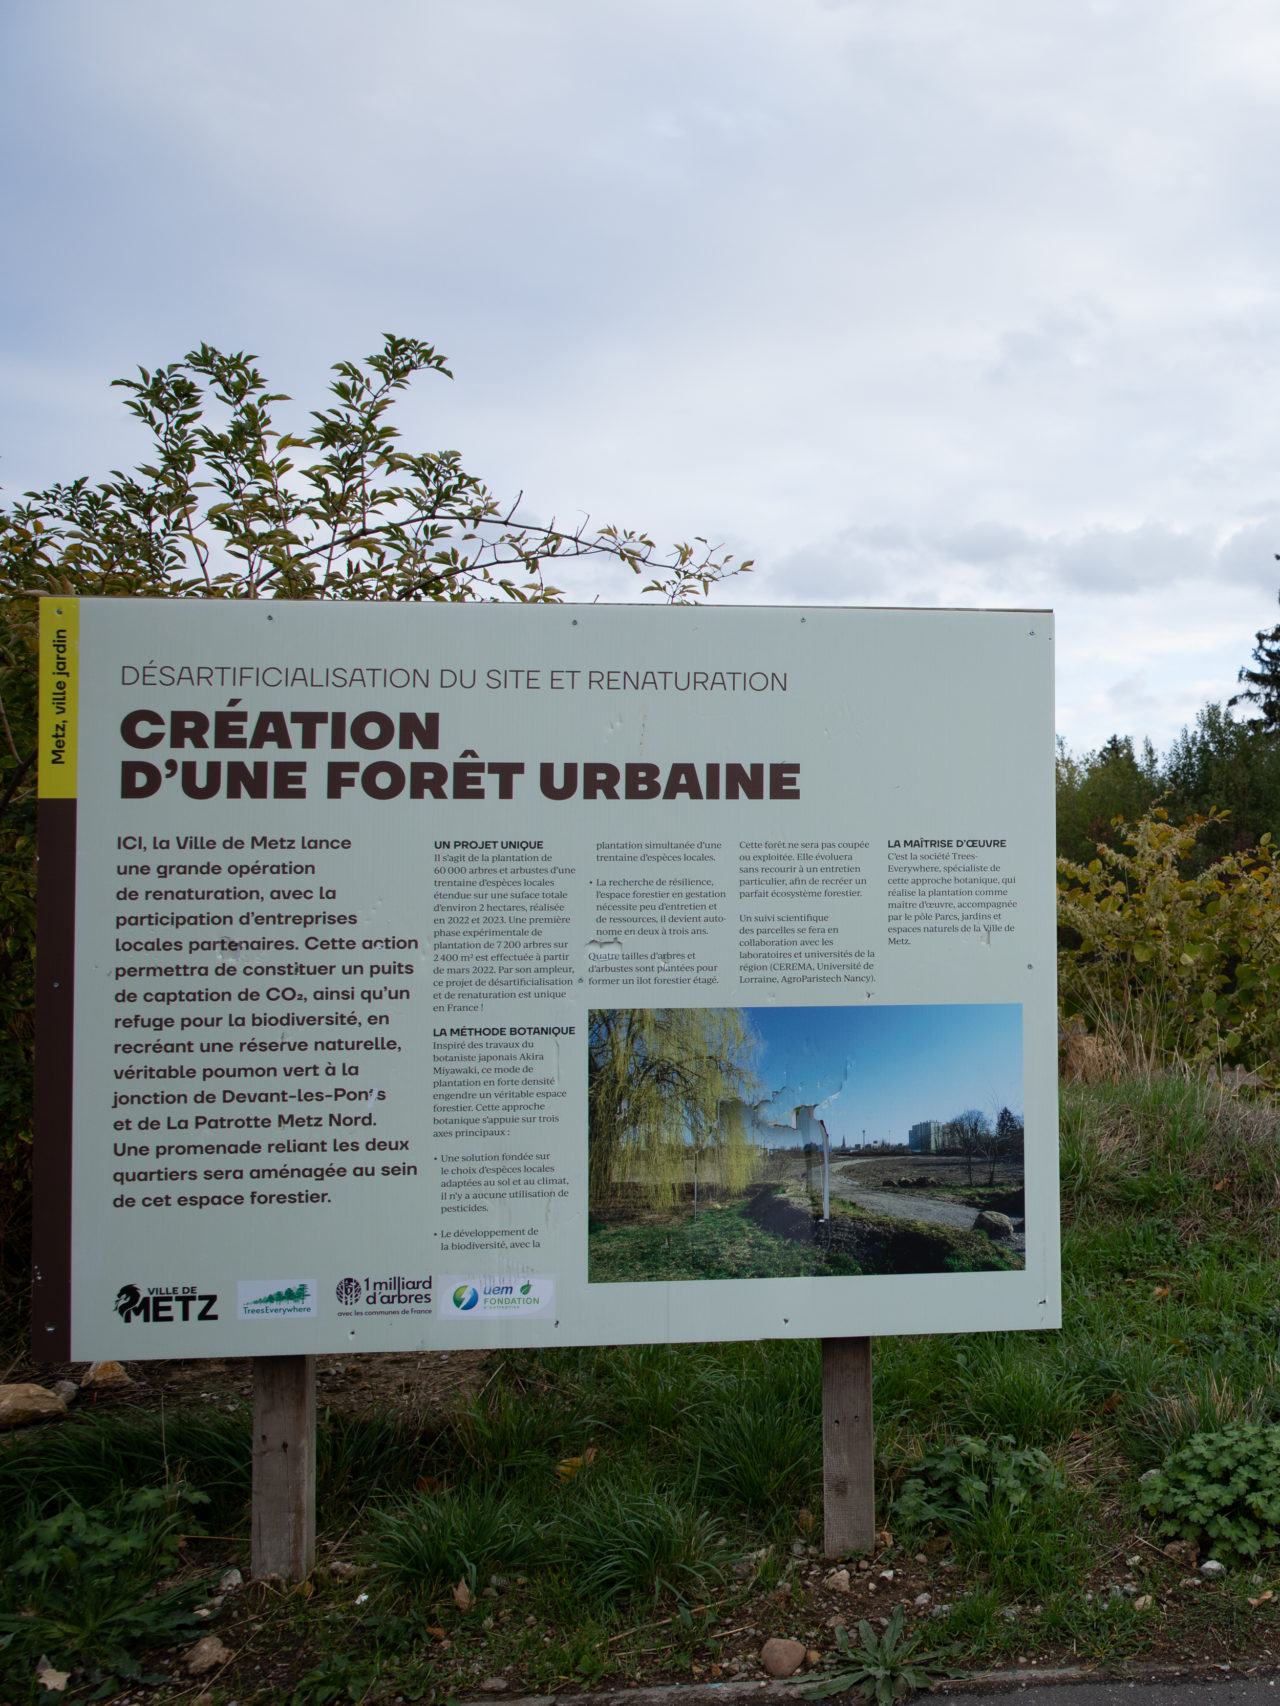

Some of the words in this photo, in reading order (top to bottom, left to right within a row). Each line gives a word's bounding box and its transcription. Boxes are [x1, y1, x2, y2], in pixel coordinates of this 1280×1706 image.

[52, 629, 69, 677] jardin
[121, 660, 430, 688] DÉSARTIFICIALISATION
[440, 668, 477, 688] DU
[486, 669, 541, 689] SITE
[550, 670, 581, 689] ET
[588, 670, 788, 691] RENATURATION
[52, 680, 66, 714] ville
[120, 698, 440, 750] CRÉATION
[51, 720, 67, 764] Metz,
[120, 758, 307, 800] D'UNE
[327, 749, 525, 800] FORÊT
[539, 761, 801, 800] URBAINE
[116, 835, 146, 851] ICI,
[152, 836, 170, 849] la
[175, 835, 216, 849] Ville
[222, 836, 245, 849] de
[250, 835, 296, 849] Metz
[300, 835, 352, 849] lance
[434, 840, 450, 849] UN
[453, 840, 498, 849] PROJET
[501, 840, 543, 851] UNIQUE
[888, 839, 901, 848] LA
[903, 837, 953, 848] MAÎTRISE
[956, 839, 1006, 847] D'ŒUVRE
[434, 853, 440, 861] Il
[442, 854, 466, 863] s'agit
[468, 853, 479, 861] de
[481, 853, 490, 861] la
[491, 853, 539, 863] plantation
[541, 853, 552, 861] de
[596, 853, 638, 861] trentaine
[640, 853, 682, 863] d'espèces
[683, 853, 715, 861] locales.
[752, 853, 794, 862] exploitée.
[797, 852, 814, 860] Elle
[815, 852, 852, 860] évoluera
[887, 852, 908, 860] C'est
[910, 852, 918, 860] la
[920, 852, 950, 860] société
[951, 852, 978, 860] Trees-
[116, 864, 151, 875] une
[156, 861, 222, 878] grande
[226, 859, 315, 878] opération
[434, 878, 478, 886] trentaine
[478, 878, 522, 888] d'espèces
[523, 878, 554, 886] locales
[115, 887, 139, 900] de
[144, 886, 264, 902] renaturation,
[269, 889, 314, 899] avec
[318, 886, 336, 899] la
[596, 902, 637, 911] nécessite
[639, 904, 656, 912] peu
[658, 902, 706, 910] d'entretien
[115, 911, 233, 929] participation
[238, 910, 357, 928] d'entreprises
[447, 916, 469, 924] 2022
[471, 916, 480, 924] et
[482, 916, 506, 924] 2023.
[508, 915, 527, 923] Une
[529, 915, 570, 925] première
[739, 914, 752, 922] Un
[777, 913, 829, 923] scientifique
[433, 928, 461, 938] phase
[462, 928, 529, 938] expérimentale
[531, 928, 542, 936] de
[115, 937, 183, 951] locales
[188, 936, 299, 954] partenaires.
[304, 936, 356, 950] Cette
[361, 935, 418, 949] action
[114, 964, 208, 980] permettra
[214, 962, 237, 976] de
[242, 961, 336, 976] constituer
[341, 964, 363, 975] un
[369, 960, 414, 978] puits
[739, 975, 779, 983] Lorraine,
[781, 974, 842, 984] AgroParistech
[844, 974, 876, 983] Nancy).
[114, 989, 138, 1002] de
[142, 987, 232, 1005] captation
[237, 987, 260, 1001] de
[312, 986, 354, 1000] ainsi
[360, 986, 410, 1003] qu'un
[114, 1013, 175, 1031] refuge
[180, 1016, 223, 1030] pour
[228, 1013, 245, 1026] la
[251, 1010, 362, 1028] biodiversité,
[366, 1014, 389, 1025] en
[433, 1028, 447, 1036] LA
[450, 1025, 506, 1036] MÉTHODE
[509, 1026, 575, 1037] BOTANIQUE
[114, 1038, 194, 1053] recréant
[199, 1042, 234, 1052] une
[239, 1036, 308, 1052] réserve
[313, 1036, 401, 1052] naturelle,
[433, 1041, 466, 1051] Inspiré
[467, 1041, 484, 1049] des
[521, 1040, 534, 1048] du
[433, 1053, 476, 1062] botaniste
[478, 1053, 517, 1062] japonais
[519, 1052, 544, 1060] Akira
[113, 1063, 196, 1079] véritable
[202, 1066, 277, 1081] poumon
[282, 1064, 319, 1076] vert
[324, 1061, 336, 1076] à
[341, 1062, 359, 1076] la
[110, 1090, 188, 1108] jonction
[192, 1089, 216, 1104] de
[112, 1118, 132, 1130] et
[137, 1116, 160, 1130] de
[166, 1115, 188, 1129] La
[194, 1114, 272, 1129] Patrotte
[277, 1113, 323, 1127] Metz
[328, 1112, 376, 1126] Nord.
[113, 1142, 150, 1156] Une
[155, 1140, 262, 1158] promenade
[267, 1138, 327, 1153] reliant
[332, 1138, 360, 1152] les
[364, 1137, 409, 1151] deux
[112, 1166, 198, 1185] quartiers
[202, 1169, 243, 1180] sera
[248, 1162, 347, 1181] aménagée
[352, 1166, 375, 1176] au
[380, 1161, 417, 1176] sein
[112, 1193, 136, 1208] de
[141, 1194, 172, 1207] cet
[176, 1194, 244, 1209] espace
[249, 1188, 331, 1204] forestier.
[441, 1203, 488, 1214] pesticides.
[148, 1287, 179, 1295] VILLE
[182, 1286, 197, 1294] DE
[364, 1277, 370, 1291] 1
[374, 1275, 432, 1291] milliard
[483, 1285, 513, 1295] uem
[366, 1291, 432, 1305] d'arbres
[483, 1297, 540, 1305] FONDATION
[124, 1295, 219, 1323] METZ
